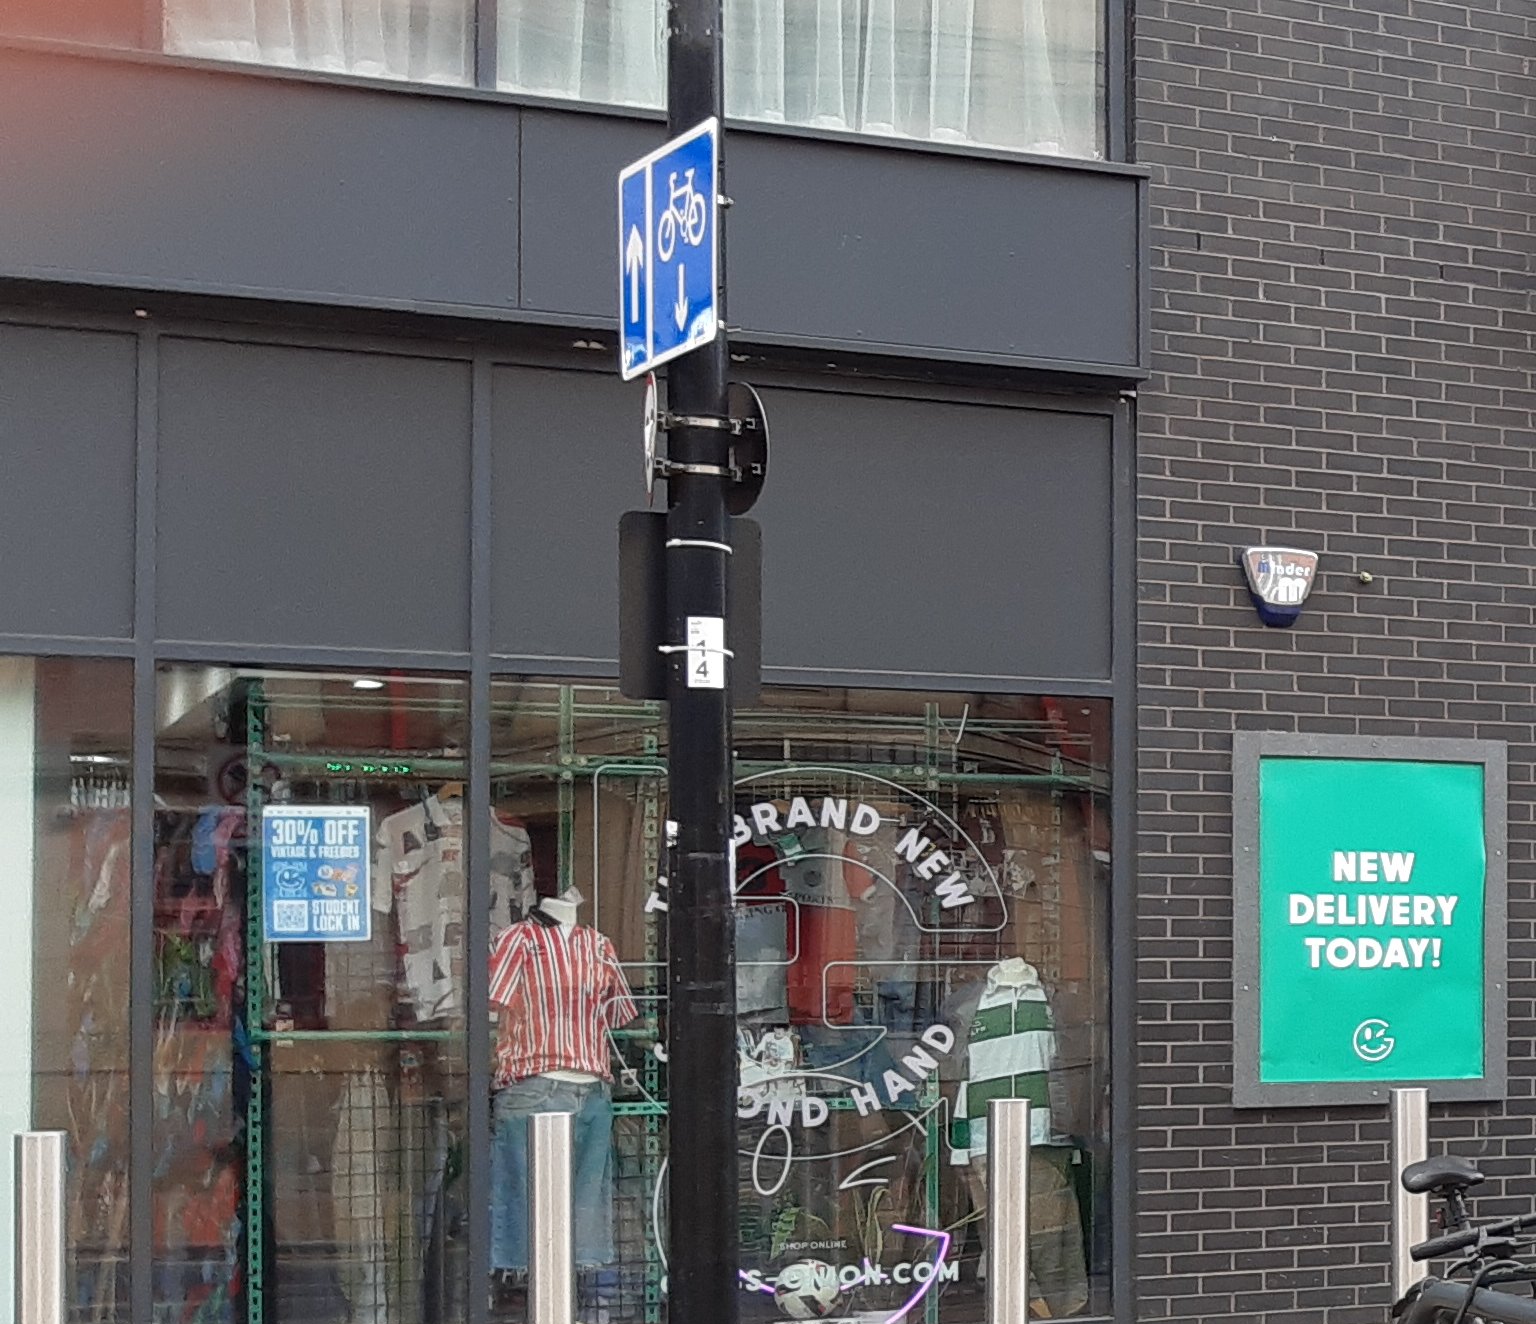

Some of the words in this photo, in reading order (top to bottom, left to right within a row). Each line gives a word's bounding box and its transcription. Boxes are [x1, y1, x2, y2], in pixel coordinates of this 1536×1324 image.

[272, 820, 319, 845] 30%
[323, 820, 359, 845] OFF
[733, 796, 881, 848] BRAND
[895, 828, 975, 908] NEW
[1334, 851, 1415, 882] NEW
[312, 900, 360, 914] STUDENT
[1289, 894, 1458, 925] DELIVERY
[313, 915, 344, 931] LOCK
[1305, 937, 1442, 968] TODAY!
[851, 1023, 955, 1116] HAND
[810, 1239, 847, 1250] ONLINE
